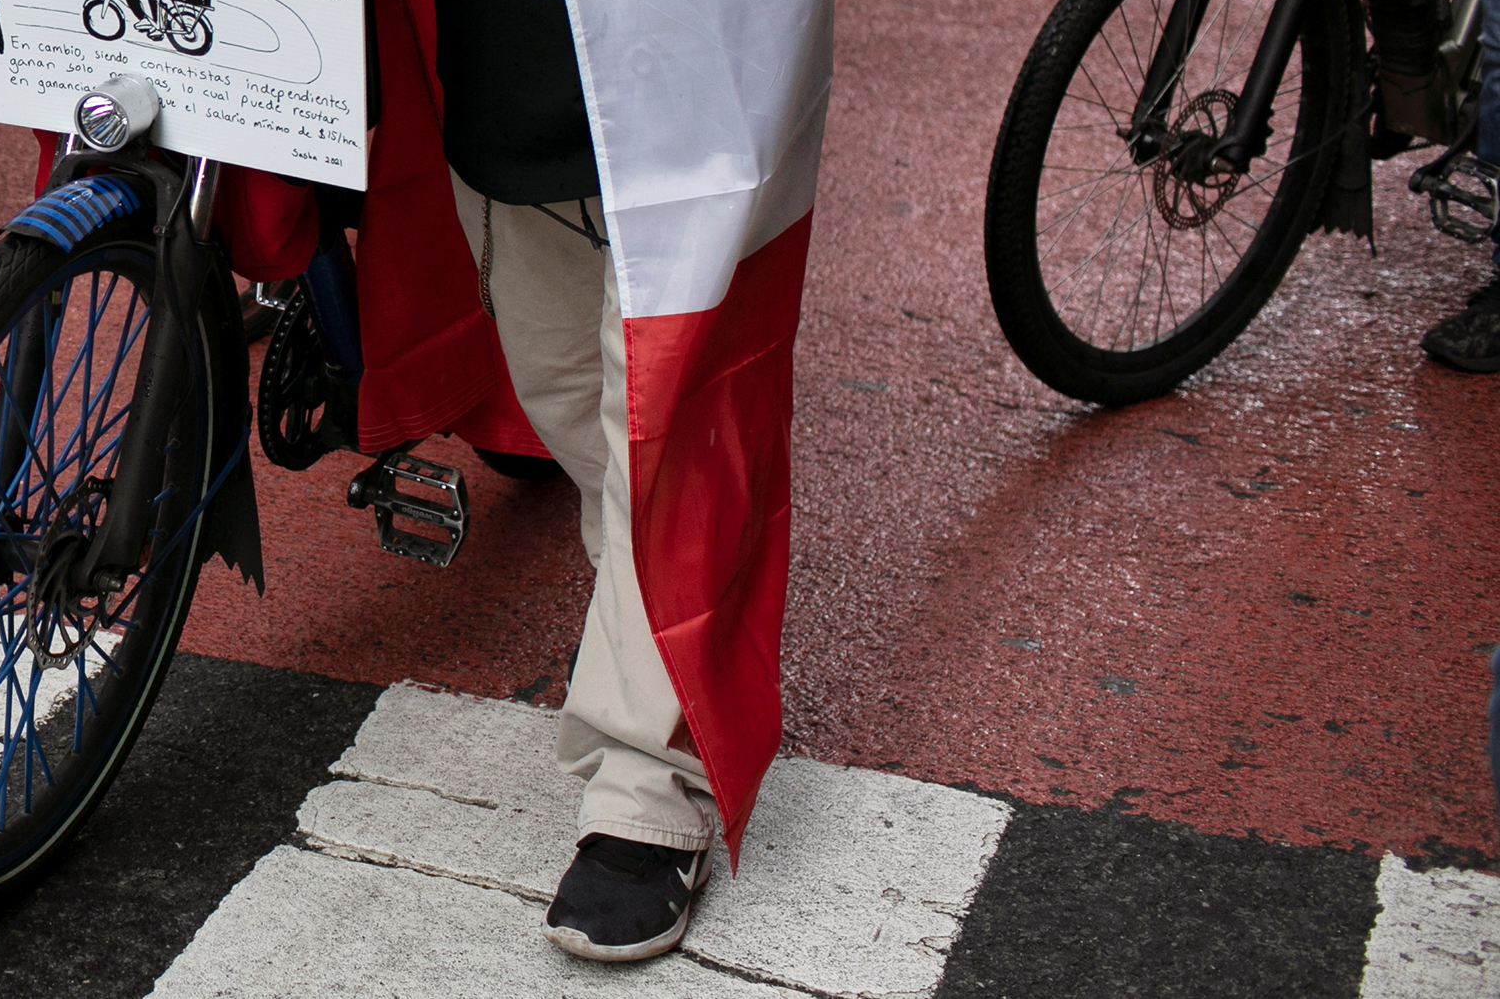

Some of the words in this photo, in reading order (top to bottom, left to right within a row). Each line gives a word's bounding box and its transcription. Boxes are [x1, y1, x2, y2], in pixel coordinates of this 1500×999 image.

[8, 56, 56, 74] ganan
[65, 62, 95, 74] solo
[181, 82, 194, 95] lo
[202, 89, 230, 102] cual
[240, 94, 283, 114] puede
[292, 105, 340, 125] resutar
[9, 35, 31, 51] En
[94, 50, 129, 65] siendo
[139, 59, 232, 86] contratistas
[9, 75, 30, 87] en
[37, 78, 97, 95] ganancia
[184, 101, 197, 114] el
[205, 106, 246, 126] salario
[297, 125, 313, 139] de
